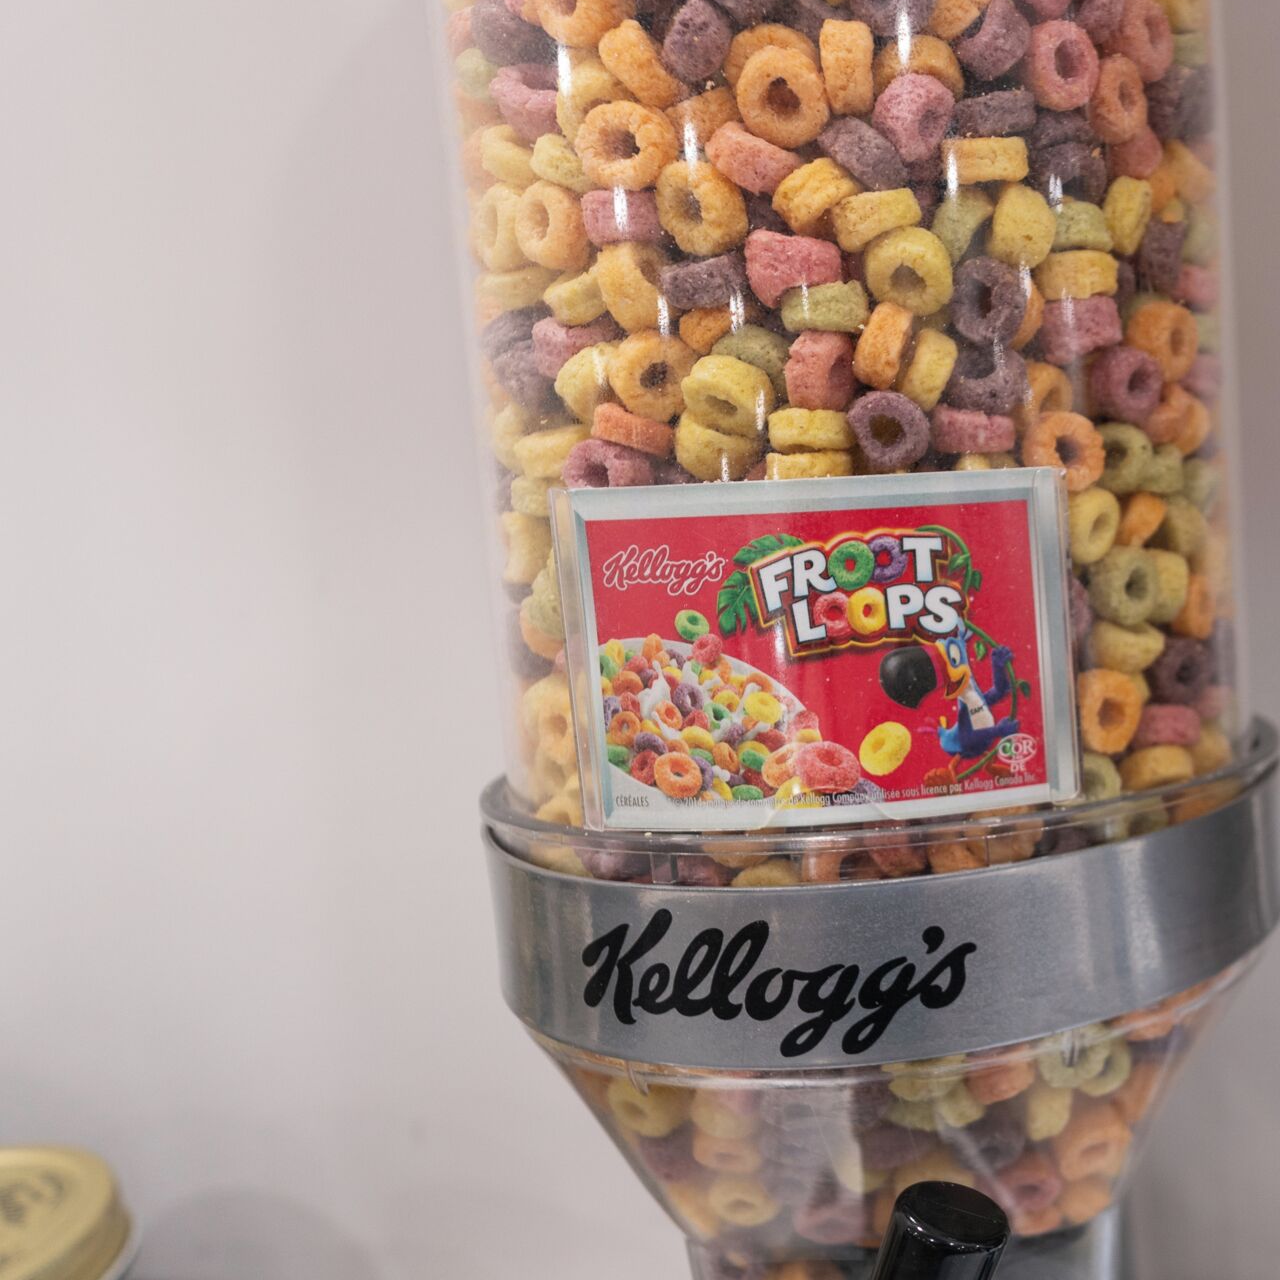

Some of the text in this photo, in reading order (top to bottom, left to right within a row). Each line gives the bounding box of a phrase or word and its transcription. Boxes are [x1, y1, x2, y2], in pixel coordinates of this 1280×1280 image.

[603, 545, 727, 595] Kellogg's
[759, 535, 943, 613] FROOT
[791, 584, 962, 644] LOOPS
[999, 739, 1034, 757] COR
[800, 792, 831, 807] Kellogg
[832, 790, 869, 805] Company
[902, 787, 919, 798] sous
[921, 784, 948, 796] licence
[949, 783, 962, 794] par
[964, 778, 994, 791] Kellogg
[994, 774, 1023, 787] Canada
[582, 908, 977, 1057] Kellogg's
